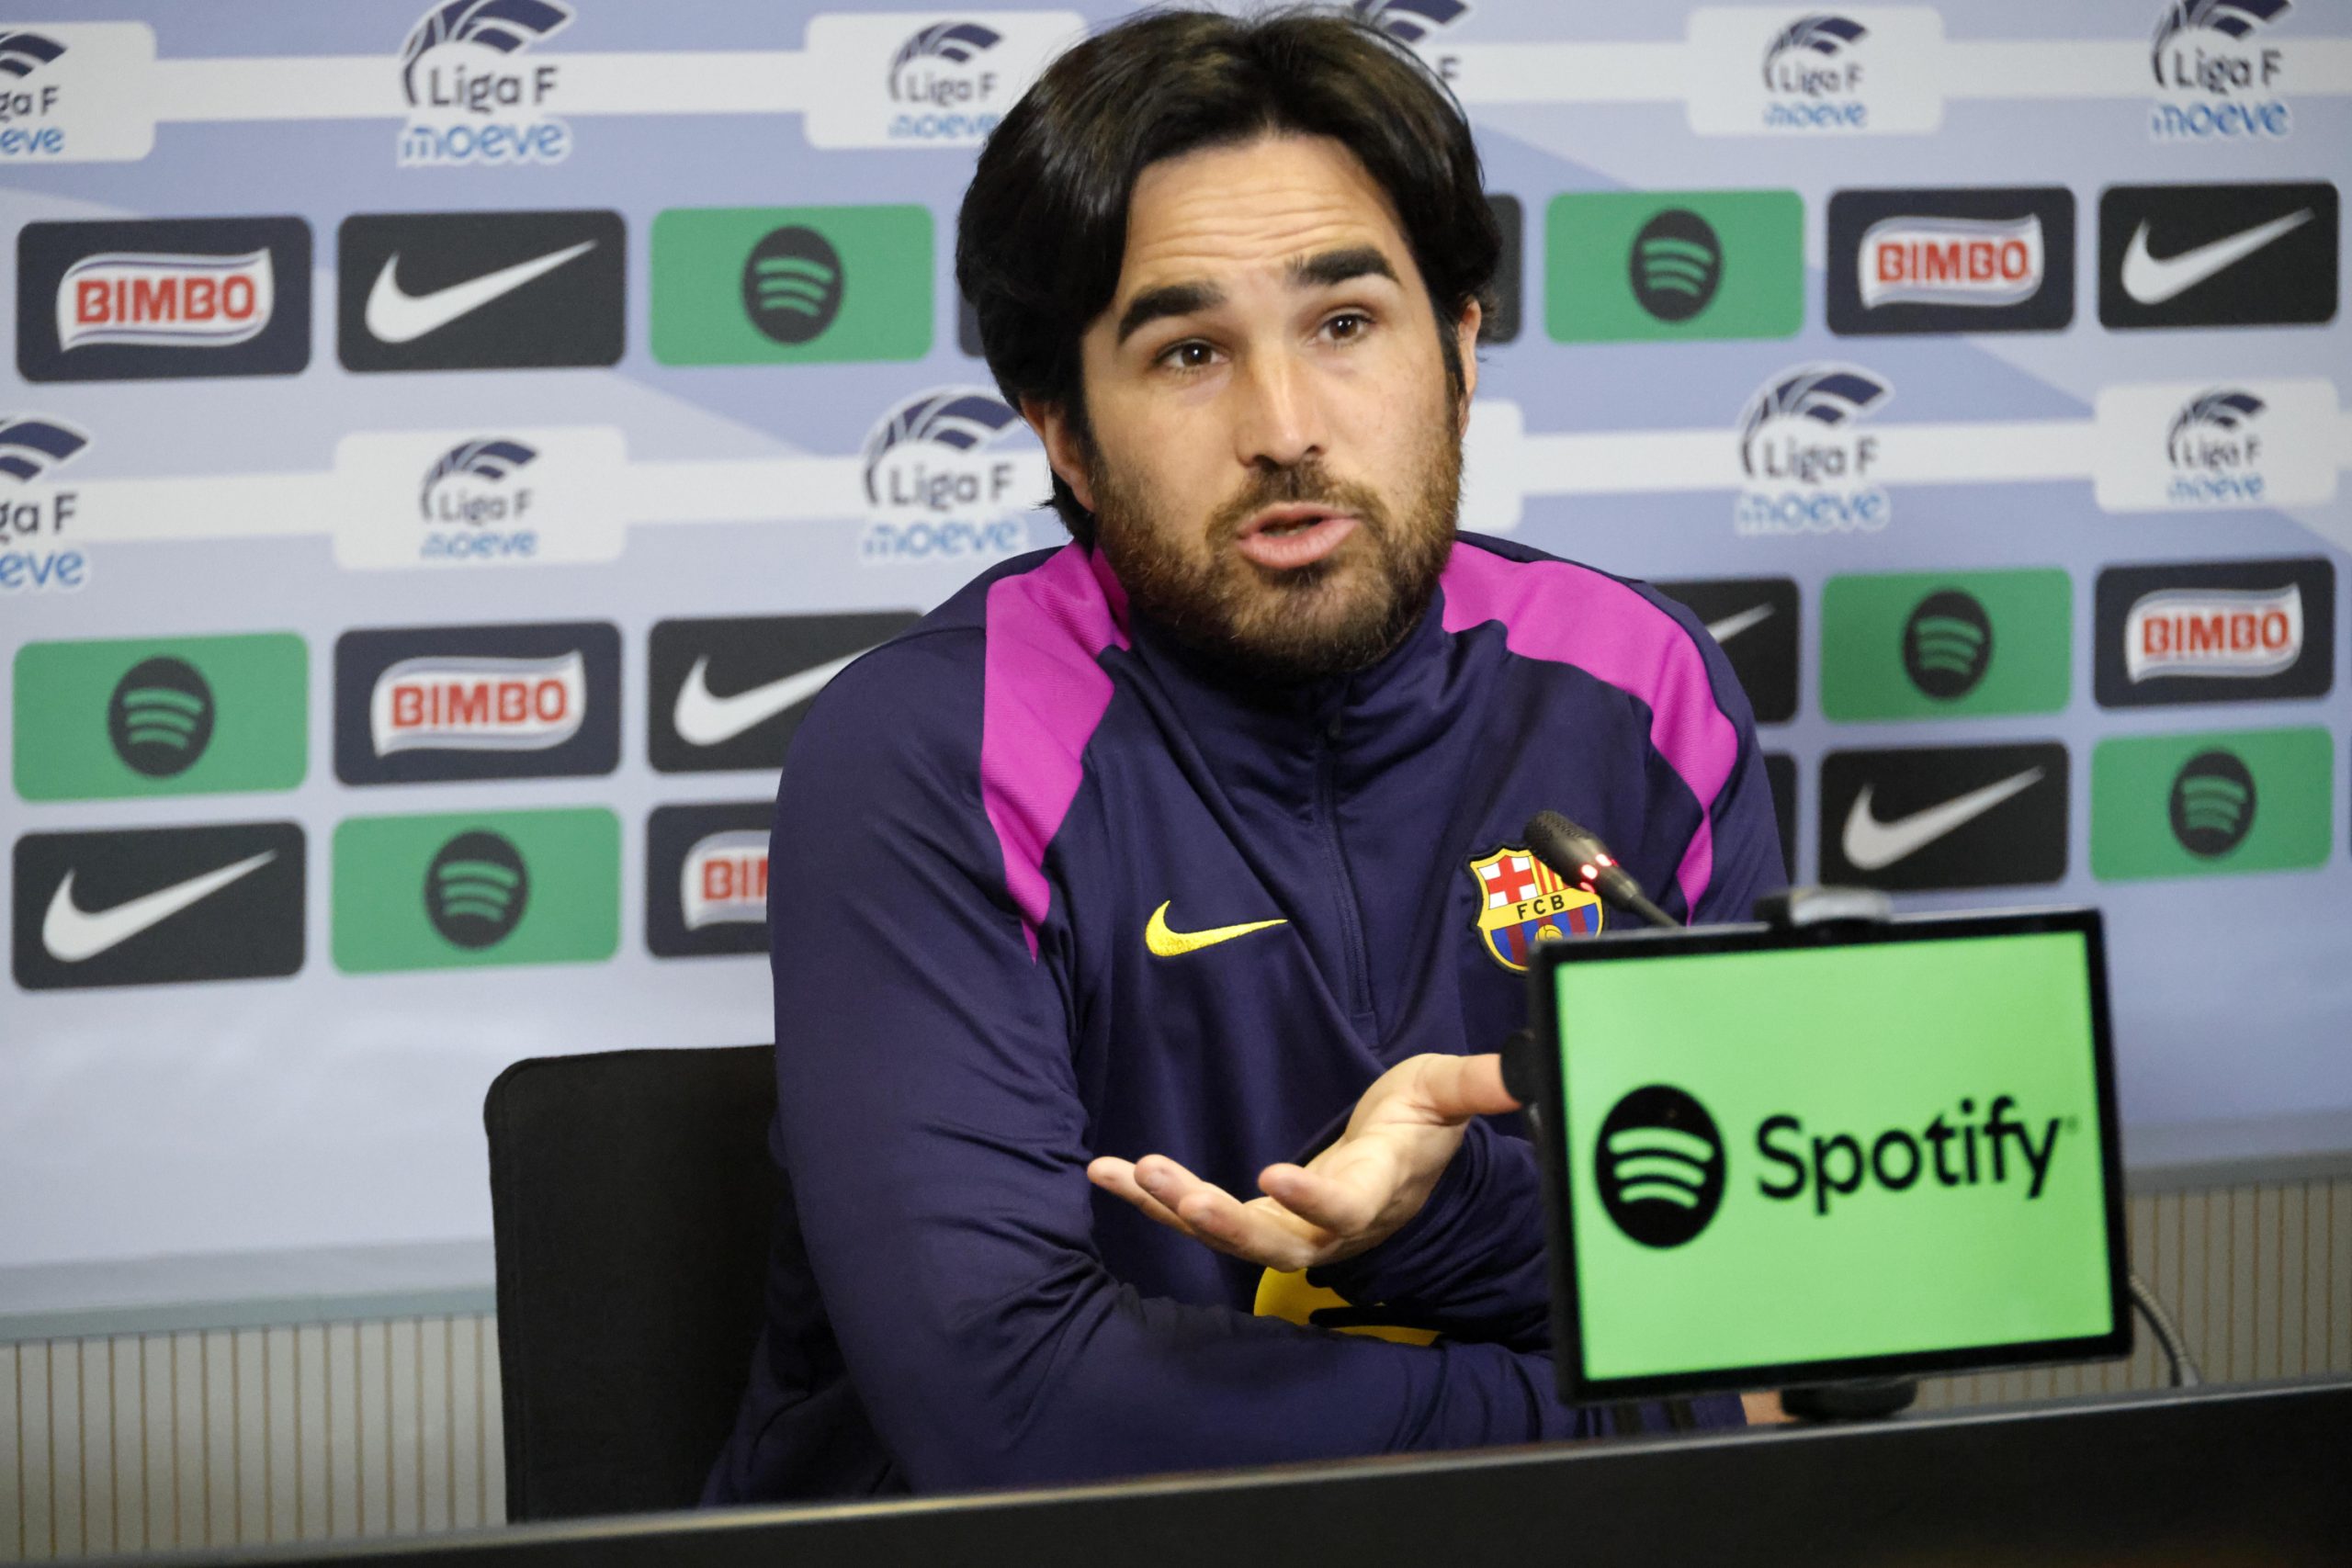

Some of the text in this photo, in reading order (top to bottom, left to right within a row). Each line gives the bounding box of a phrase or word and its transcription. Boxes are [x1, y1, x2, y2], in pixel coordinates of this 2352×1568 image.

[431, 65, 557, 113] Liga F
[905, 71, 997, 107] Liga F
[1780, 61, 1864, 97] Liga F
[2175, 46, 2282, 95] Liga F
[40, 85, 60, 117] F
[2152, 102, 2289, 135] moeve
[0, 129, 64, 154] eve
[402, 125, 563, 158] moeve
[1876, 239, 2030, 285] BIMBO
[75, 275, 256, 326] BIMBO
[1763, 435, 1879, 485] Liga F
[2245, 434, 2263, 467] F
[889, 463, 1012, 512] Liga F
[53, 492, 77, 534] F
[440, 488, 533, 525] Liga F
[864, 521, 1019, 557] moeve
[0, 552, 85, 587] eve
[2142, 610, 2290, 657] BIMBO
[390, 679, 568, 729] BIMBO
[1516, 894, 1566, 920] FCB
[1756, 1095, 2062, 1216] Spotify
